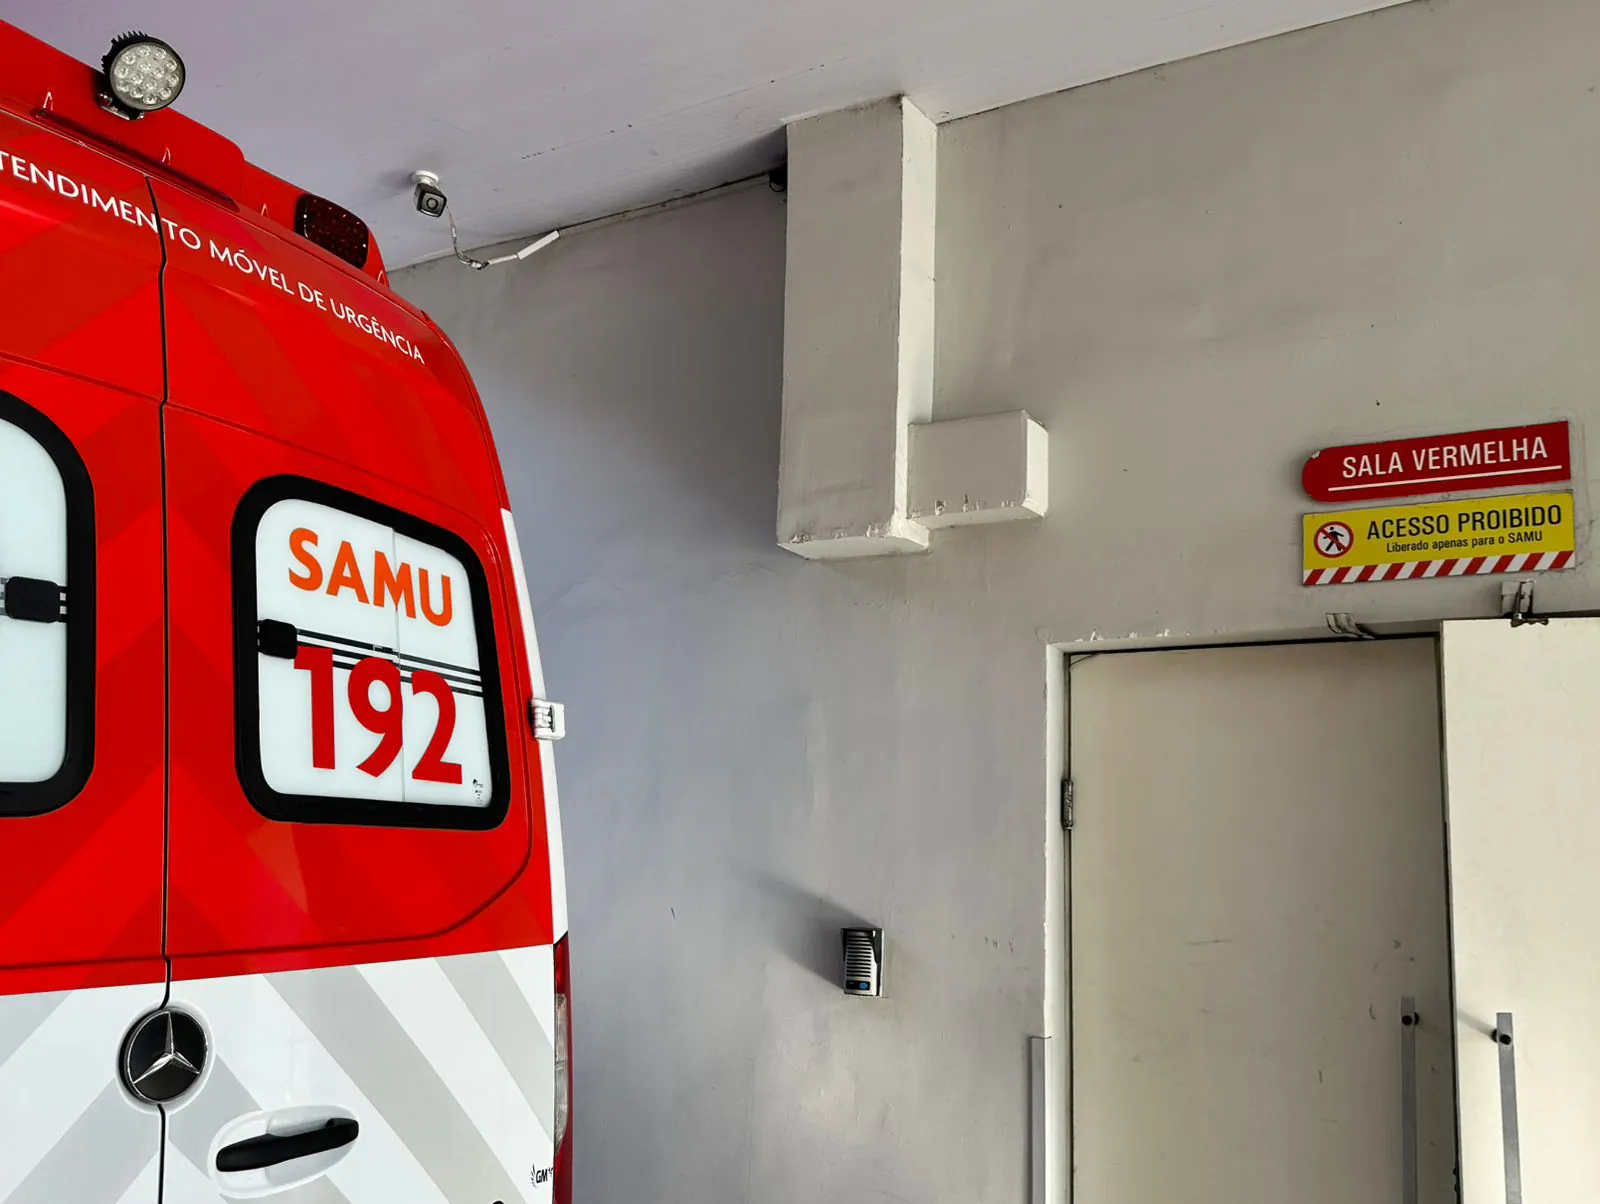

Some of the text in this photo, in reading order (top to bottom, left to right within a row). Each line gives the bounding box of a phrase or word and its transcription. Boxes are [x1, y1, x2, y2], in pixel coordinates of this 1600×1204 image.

[209, 240, 294, 295] MÓVEL
[298, 281, 327, 311] DE
[329, 298, 425, 364] URGÊNCIA
[1342, 436, 1548, 479] SALA VERMELHA
[1367, 504, 1562, 541] ACESSO PROIBIDO
[1386, 530, 1543, 553] Liberado apenas para o SAMU
[288, 526, 453, 627] SAMU
[293, 645, 463, 785] 192
